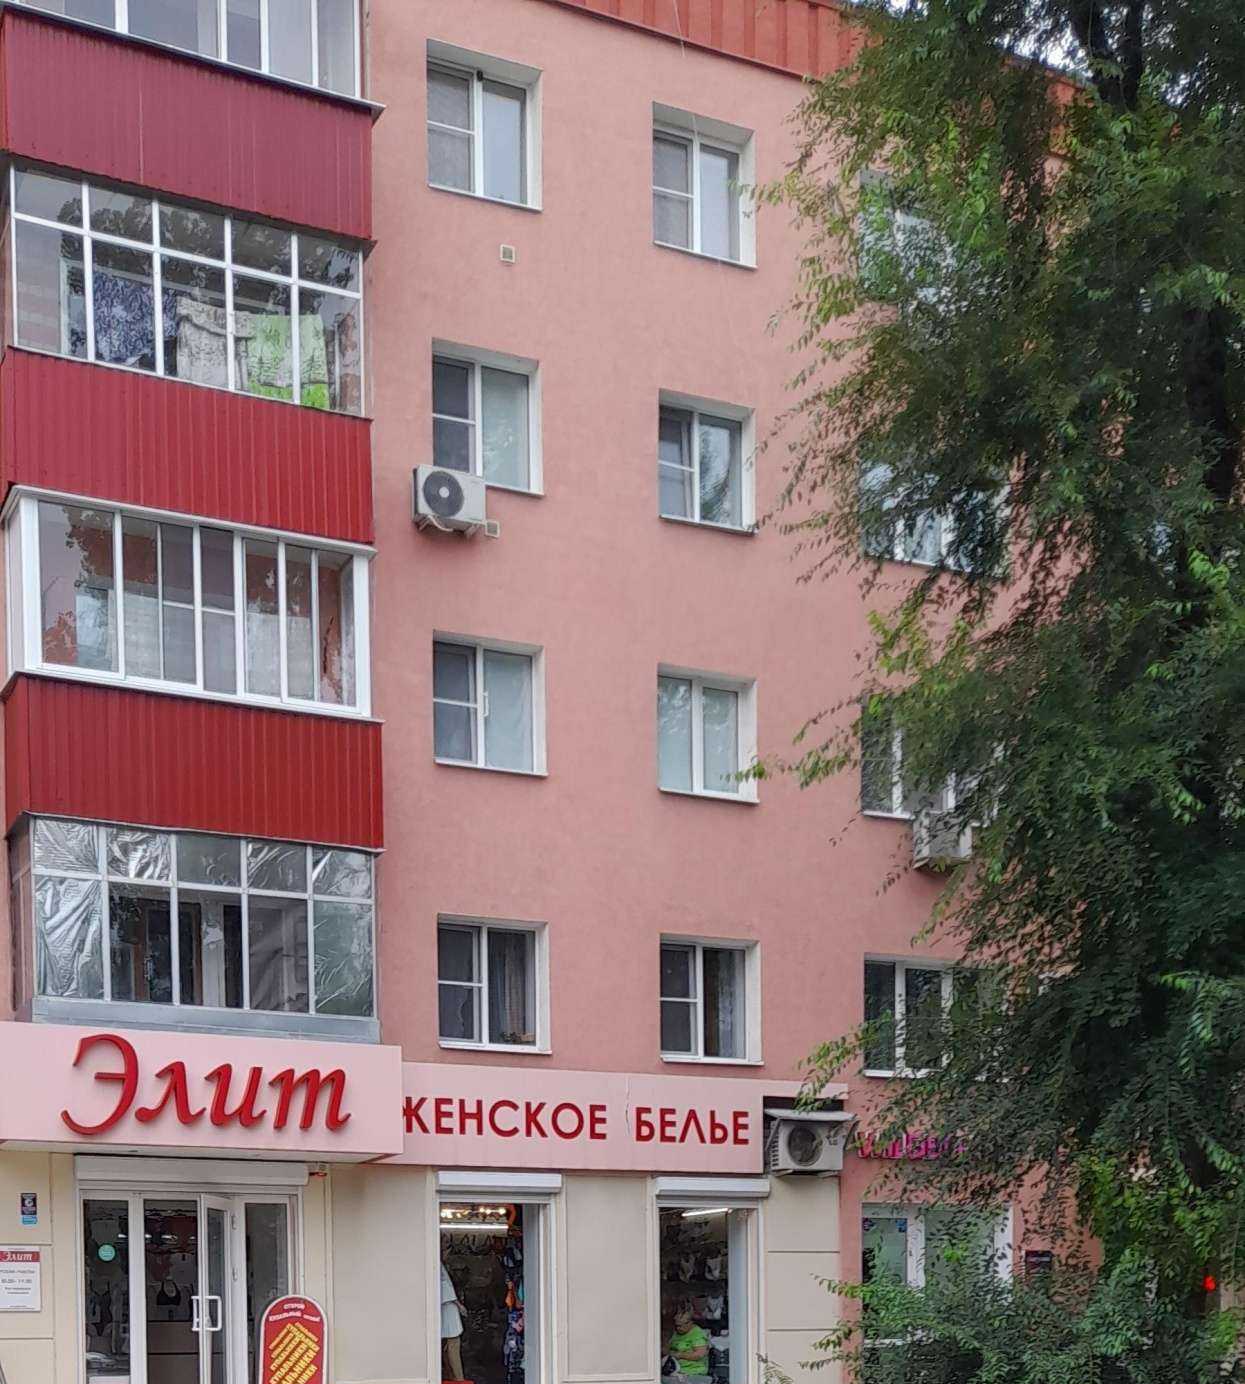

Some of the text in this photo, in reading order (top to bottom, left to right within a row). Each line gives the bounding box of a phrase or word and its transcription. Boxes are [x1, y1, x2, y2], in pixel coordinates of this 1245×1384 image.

[60, 1033, 351, 1136] Элит
[402, 1096, 751, 1146] ЖЕНСКОЕ БЕЛЬЕ
